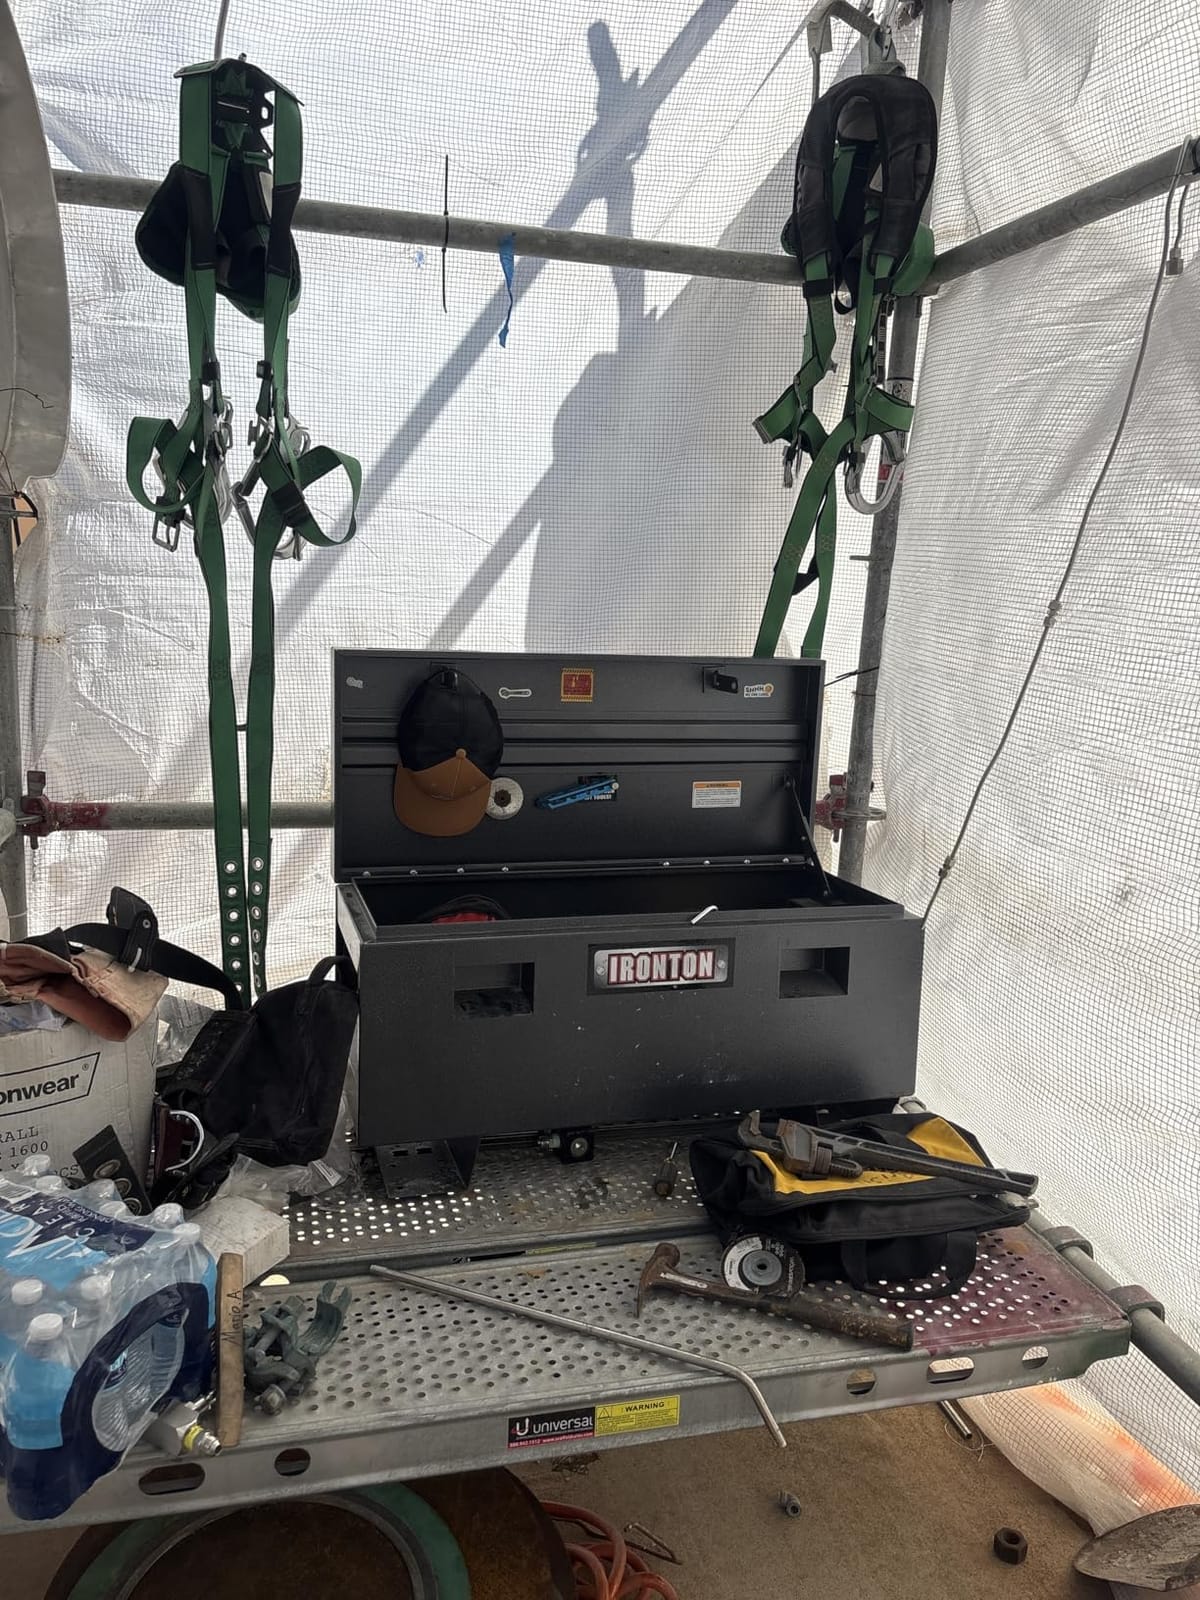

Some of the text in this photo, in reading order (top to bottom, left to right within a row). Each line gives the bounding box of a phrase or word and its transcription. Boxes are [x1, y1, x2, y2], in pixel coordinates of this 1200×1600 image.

[608, 950, 716, 984] IRONTON
[10, 1141, 48, 1158] 1600
[54, 1164, 79, 1178] CS
[625, 1401, 665, 1412] WARNING
[533, 1416, 593, 1434] universal
